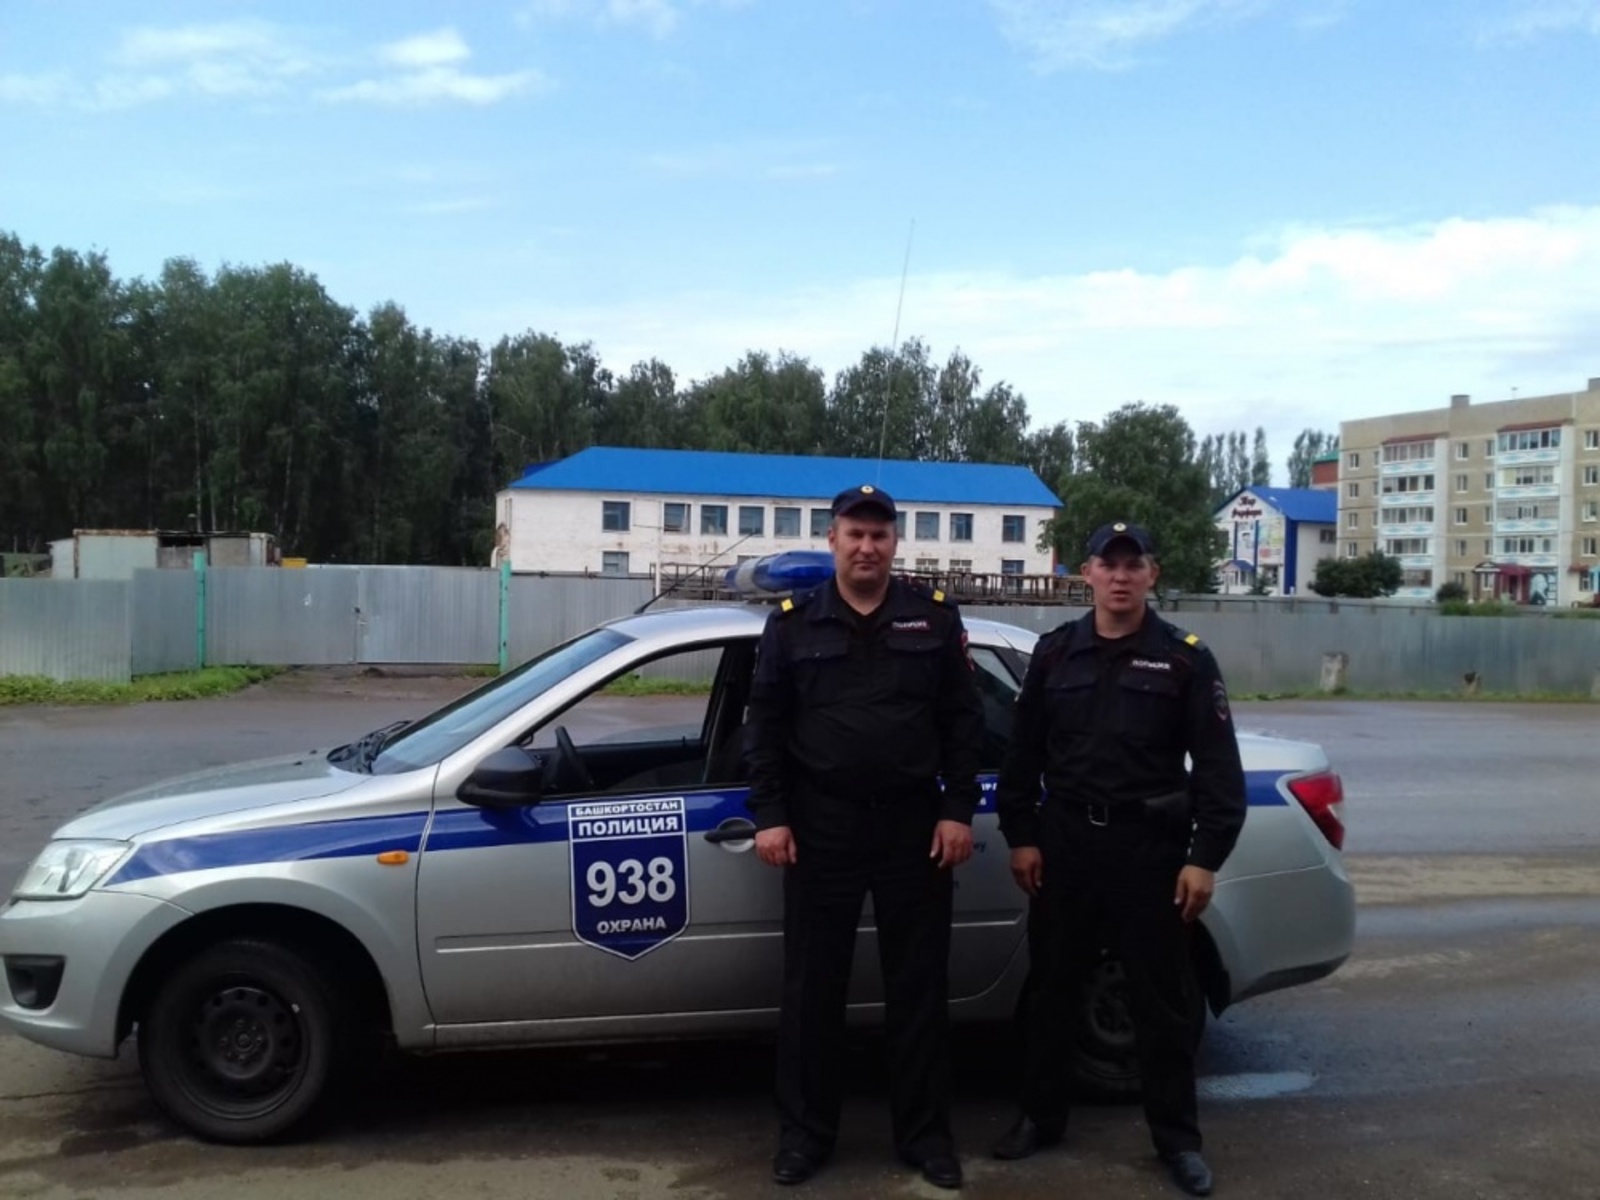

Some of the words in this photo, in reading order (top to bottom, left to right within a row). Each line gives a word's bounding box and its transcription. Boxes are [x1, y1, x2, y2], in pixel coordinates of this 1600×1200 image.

[575, 801, 678, 816] БАШКОРТОСТАН
[578, 816, 678, 836] ПОЛИЦИЯ
[586, 856, 676, 907] 938
[597, 916, 666, 934] ОХРАНА
